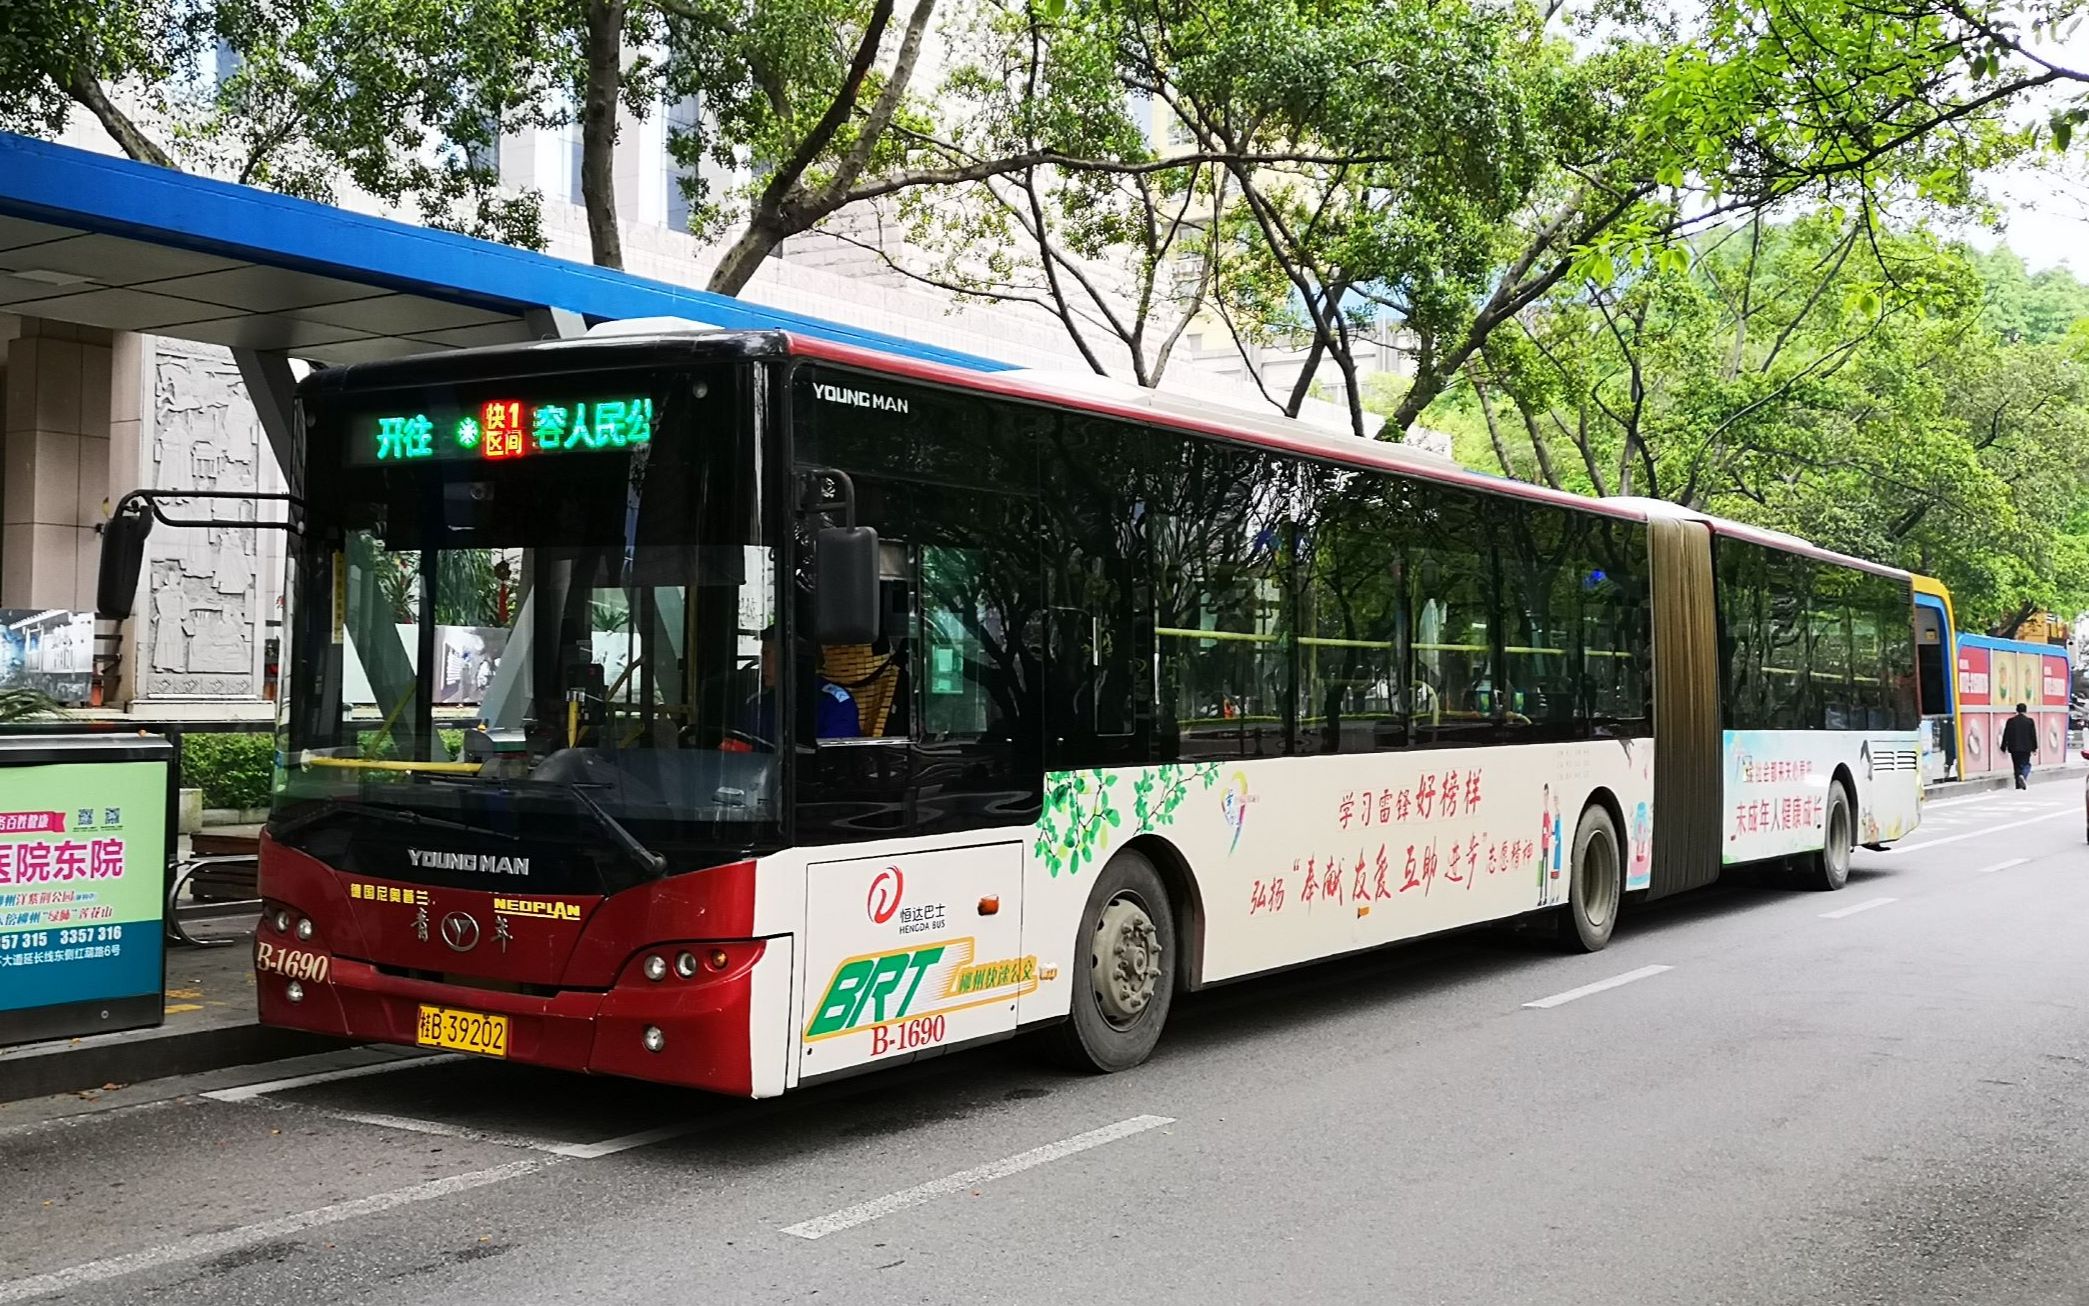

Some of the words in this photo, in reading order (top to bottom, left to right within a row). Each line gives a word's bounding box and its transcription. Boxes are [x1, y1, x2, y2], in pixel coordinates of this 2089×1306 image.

[486, 402, 521, 430] 快1
[376, 414, 433, 459] 开往
[486, 430, 523, 456] 区间
[1339, 768, 1482, 829] 学习雷锋好榜样
[1736, 795, 1822, 834] 未成年人健康成长
[494, 898, 581, 920] NEOPLAN
[900, 903, 946, 924] 恒达巴士
[22, 932, 48, 948] 315
[60, 928, 94, 945] 3357
[98, 926, 122, 942] 316
[899, 924, 929, 935] HENGDA
[932, 920, 946, 931] BUS
[0, 944, 121, 968] 大道延长线东侧红路6号
[257, 941, 328, 985] B-1690
[806, 946, 947, 1037] BRT
[870, 1014, 947, 1056] B-1690
